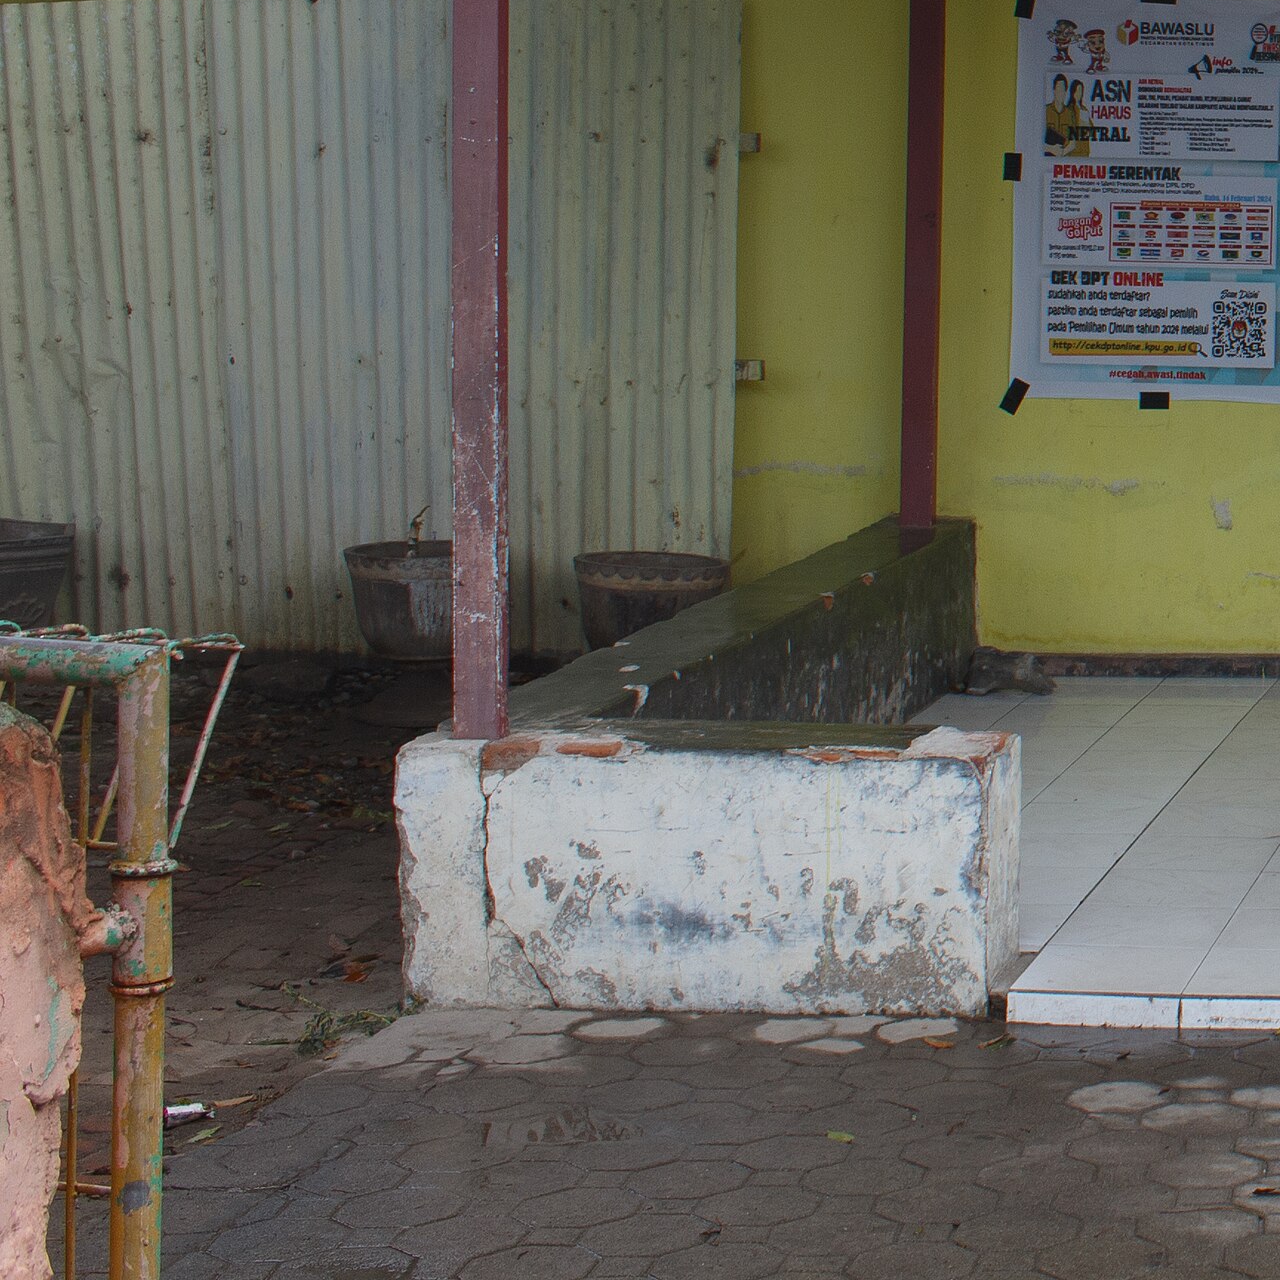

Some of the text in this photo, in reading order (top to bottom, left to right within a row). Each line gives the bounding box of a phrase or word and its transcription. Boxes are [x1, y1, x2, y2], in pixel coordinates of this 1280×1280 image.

[1140, 21, 1215, 35] BAWASLU
[1212, 56, 1233, 67] info
[1091, 79, 1132, 103] ASN
[1091, 105, 1132, 120] HARUS
[1067, 126, 1131, 142] NETRAL
[1053, 164, 1181, 182] PEMILU SERENTAK
[1051, 270, 1164, 286] CEK DPT ONLINE
[1048, 289, 1086, 300] sudahkah
[1088, 290, 1108, 300] anda
[1078, 305, 1098, 317] anda
[1099, 306, 1137, 318] terdaftar
[1138, 307, 1168, 319] sebagai
[1047, 321, 1067, 333] pada
[1136, 322, 1160, 334] tahun
[1161, 323, 1179, 333] 2024
